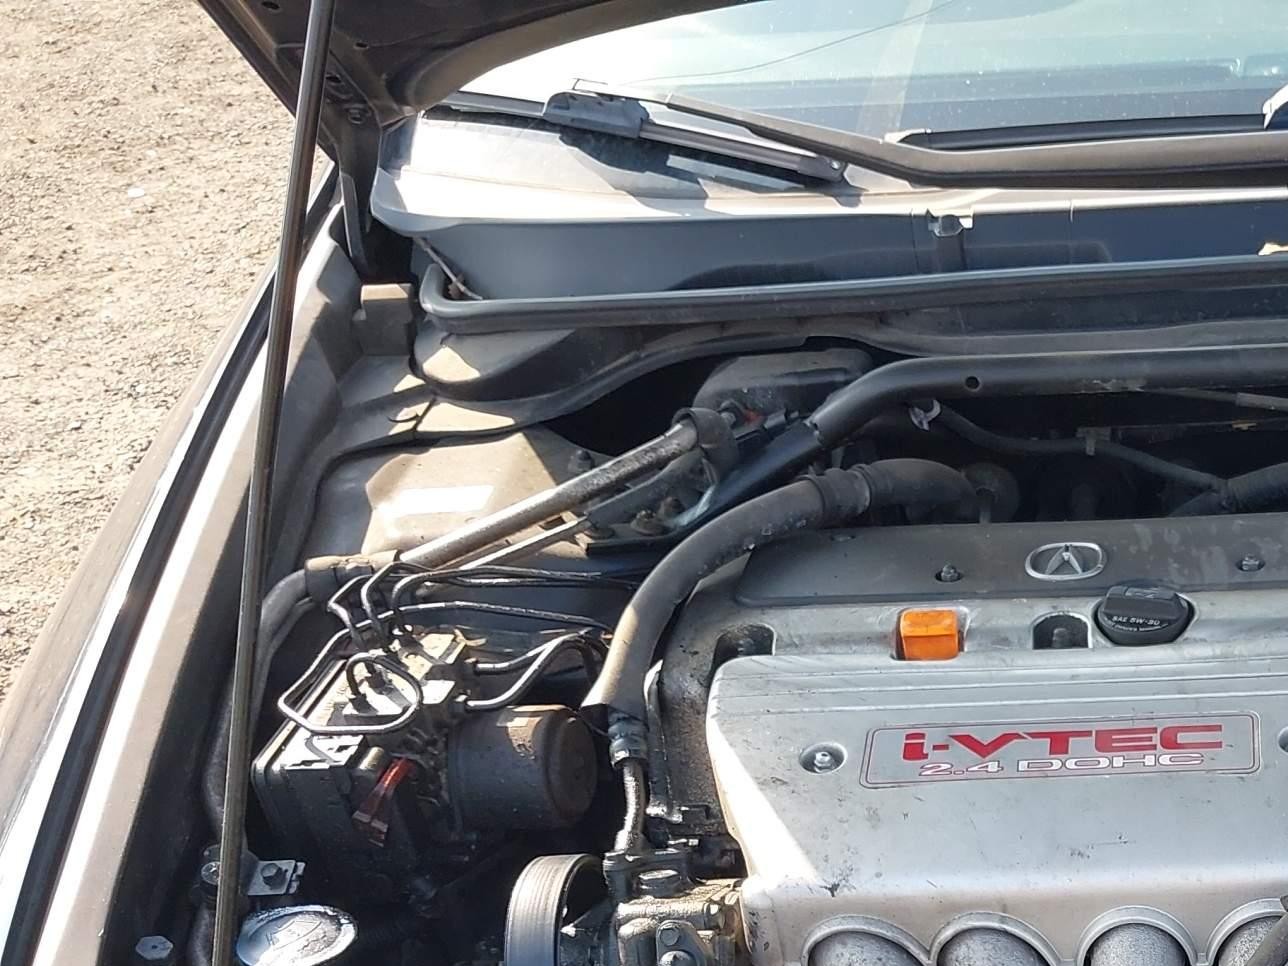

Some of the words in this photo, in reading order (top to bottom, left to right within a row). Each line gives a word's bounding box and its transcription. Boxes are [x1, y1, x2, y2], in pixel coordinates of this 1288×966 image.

[902, 724, 1223, 761] i-VTEC
[918, 760, 1004, 777] 2.4
[1017, 752, 1205, 773] DOHC
